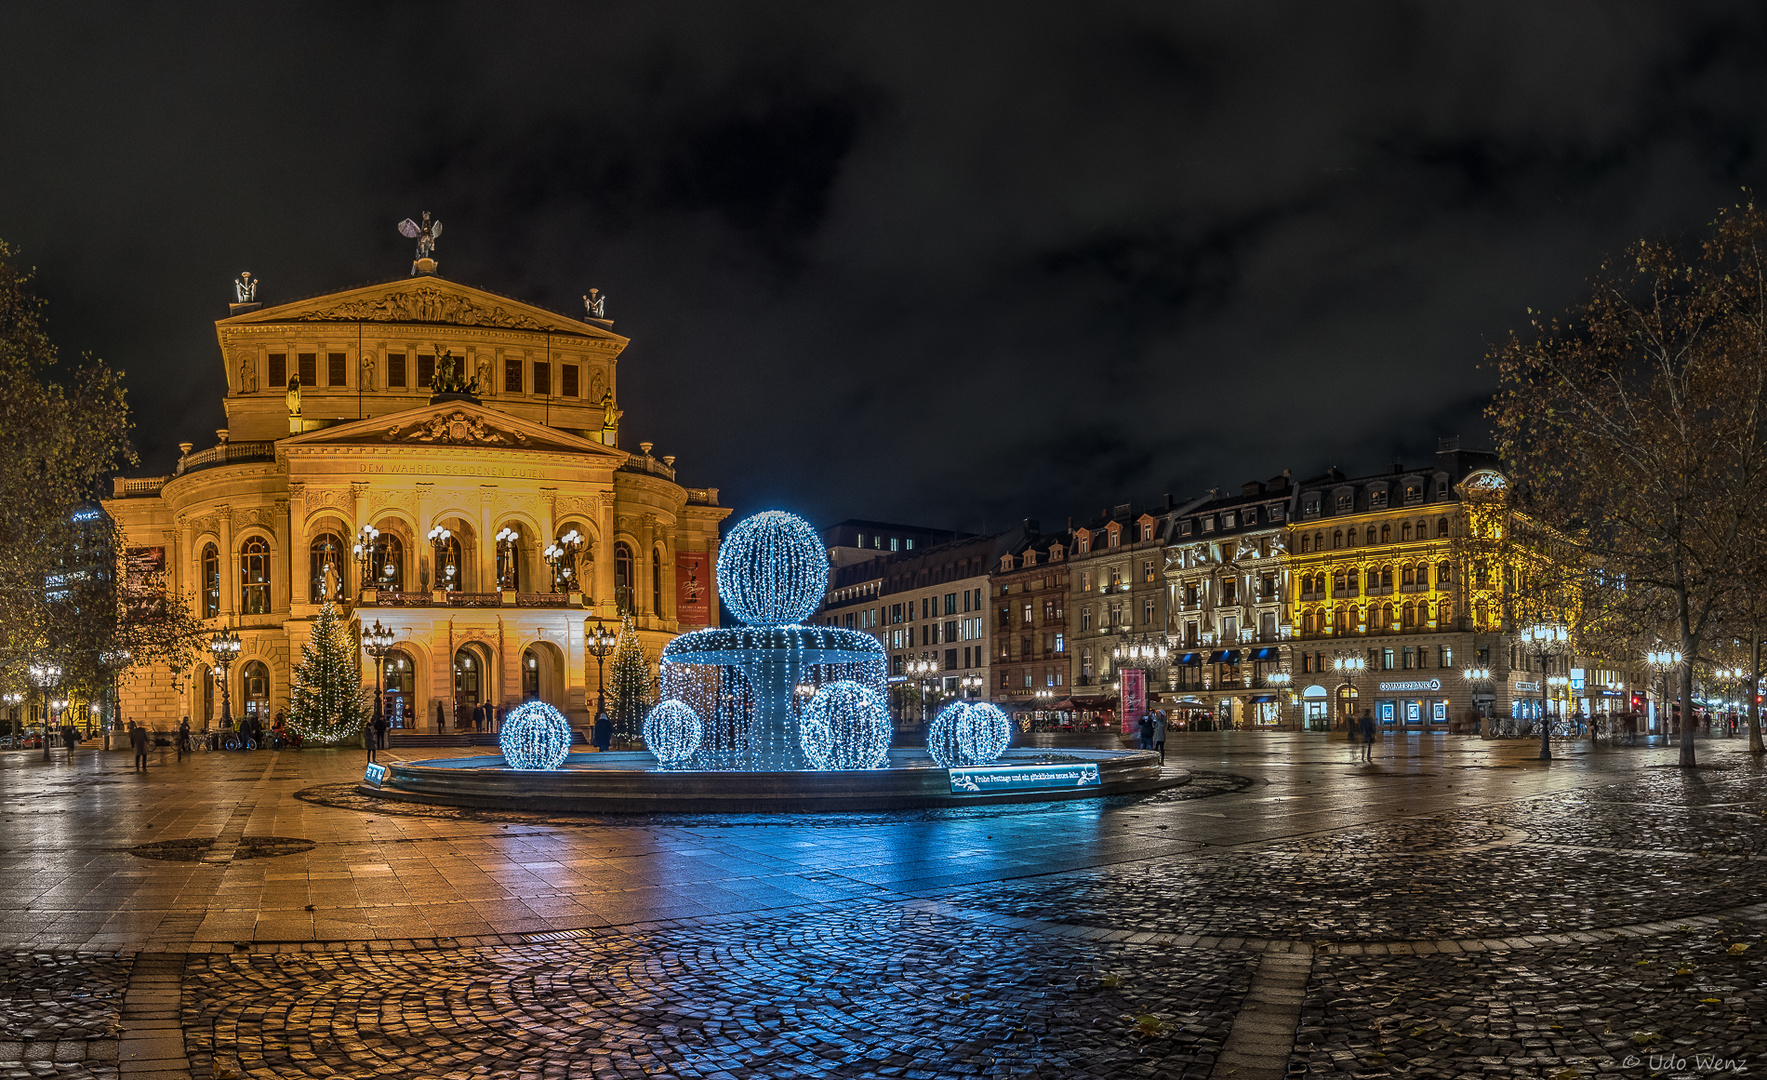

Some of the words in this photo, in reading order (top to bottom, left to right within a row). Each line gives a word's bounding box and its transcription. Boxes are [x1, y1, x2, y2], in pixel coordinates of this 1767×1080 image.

[360, 463, 384, 473] DEM
[390, 464, 439, 474] WAHREN
[445, 465, 506, 477] SCHOENEN
[1379, 681, 1430, 691] COMMERZBANK
